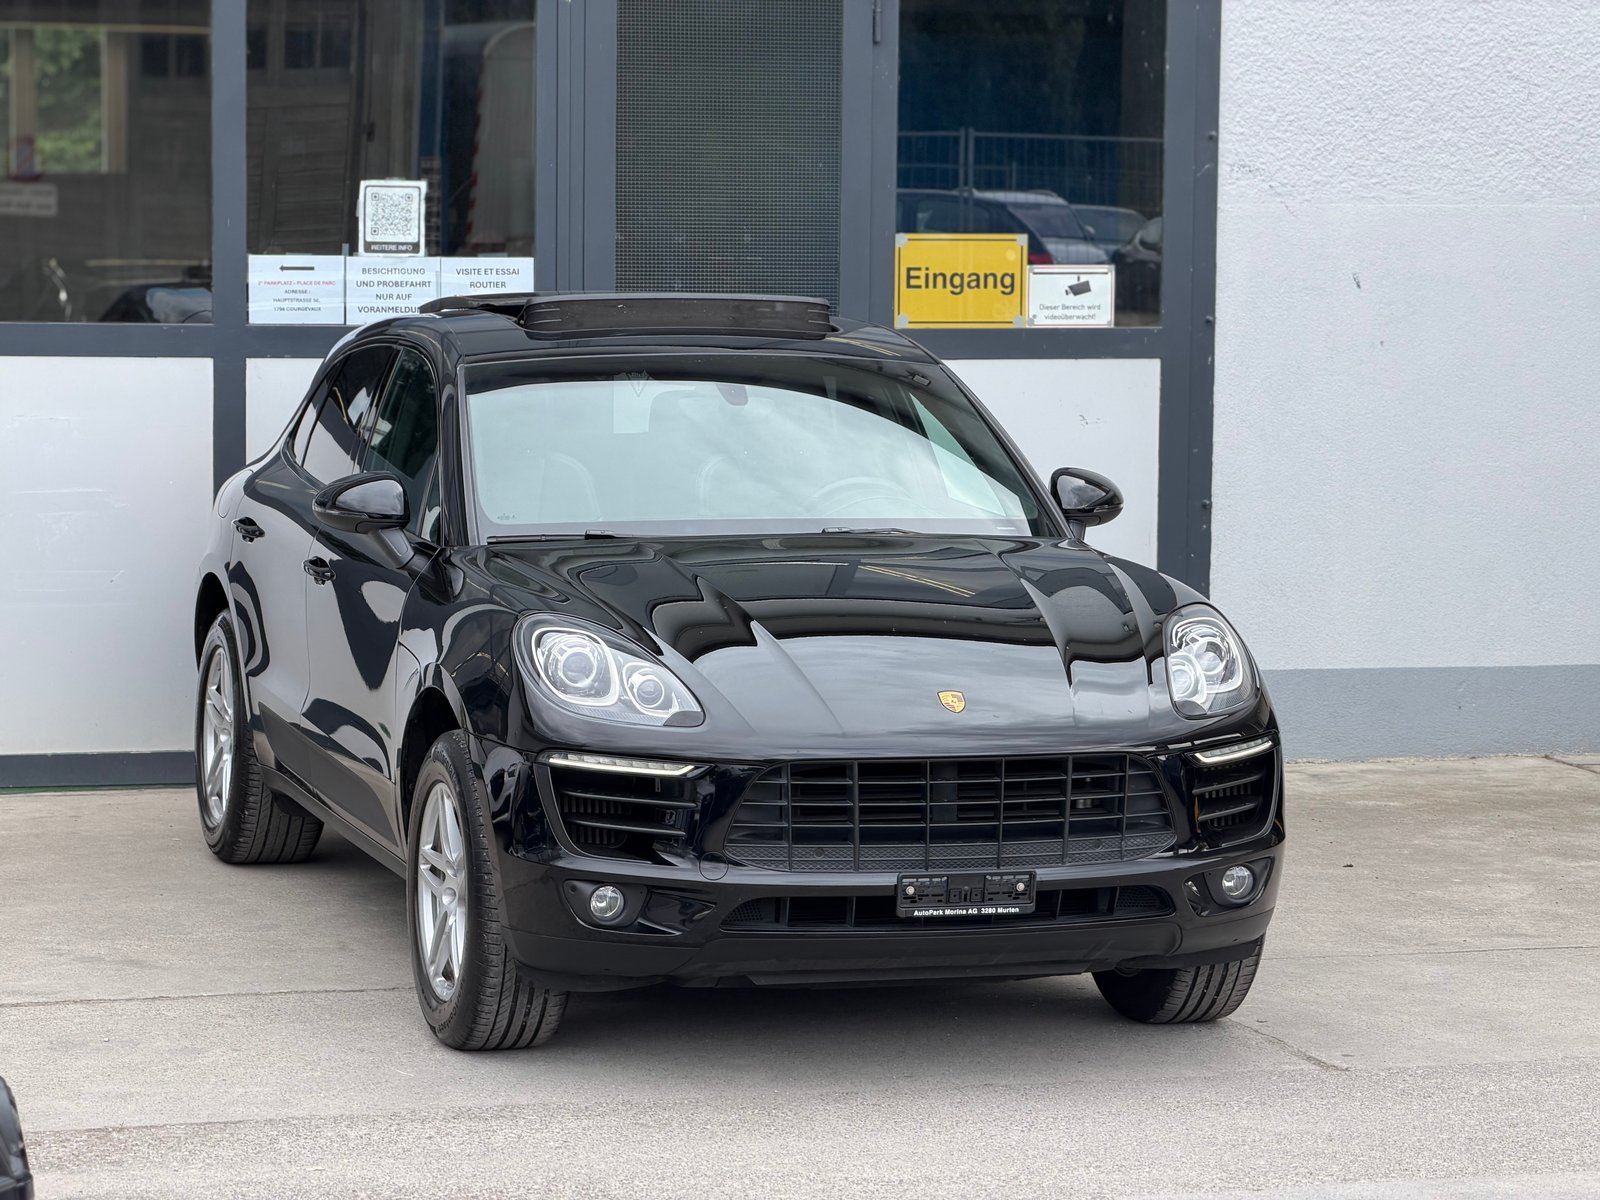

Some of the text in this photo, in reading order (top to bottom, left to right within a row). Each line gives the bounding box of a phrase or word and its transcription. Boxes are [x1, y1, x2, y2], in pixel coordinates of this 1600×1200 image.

[361, 267, 426, 275] BESICHTIGUNG
[455, 268, 520, 276] VISITE ET ESSAI
[356, 280, 432, 288] UND PROBEFAHRT
[469, 281, 507, 289] ROUTIER
[906, 266, 1015, 296] Eingang
[375, 293, 413, 301] NUR AUF
[1039, 303, 1101, 311] Dieser Bereich wird
[997, 906, 1019, 914] Murten
